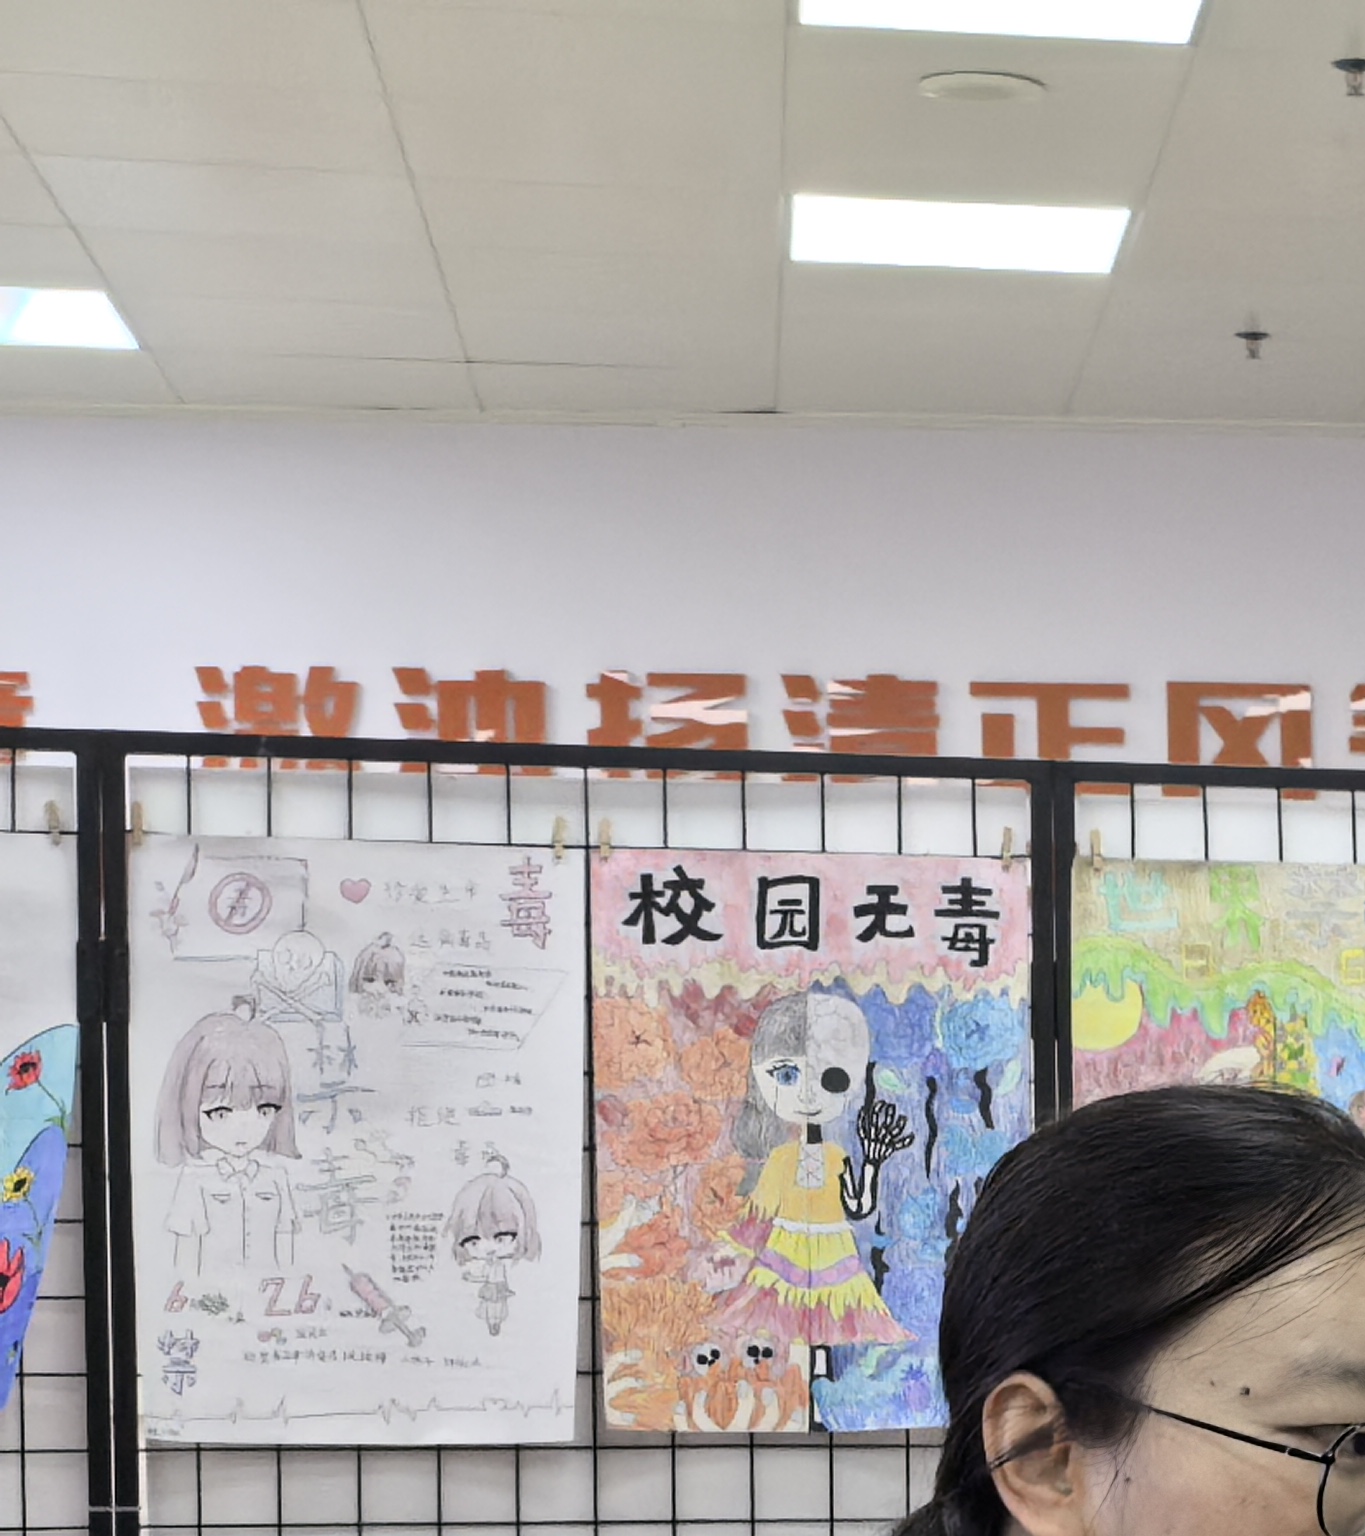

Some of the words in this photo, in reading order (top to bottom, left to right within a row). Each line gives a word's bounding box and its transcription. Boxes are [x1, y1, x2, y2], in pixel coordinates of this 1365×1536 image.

[498, 856, 553, 950] 毒
[622, 863, 1001, 968] 校园无毒
